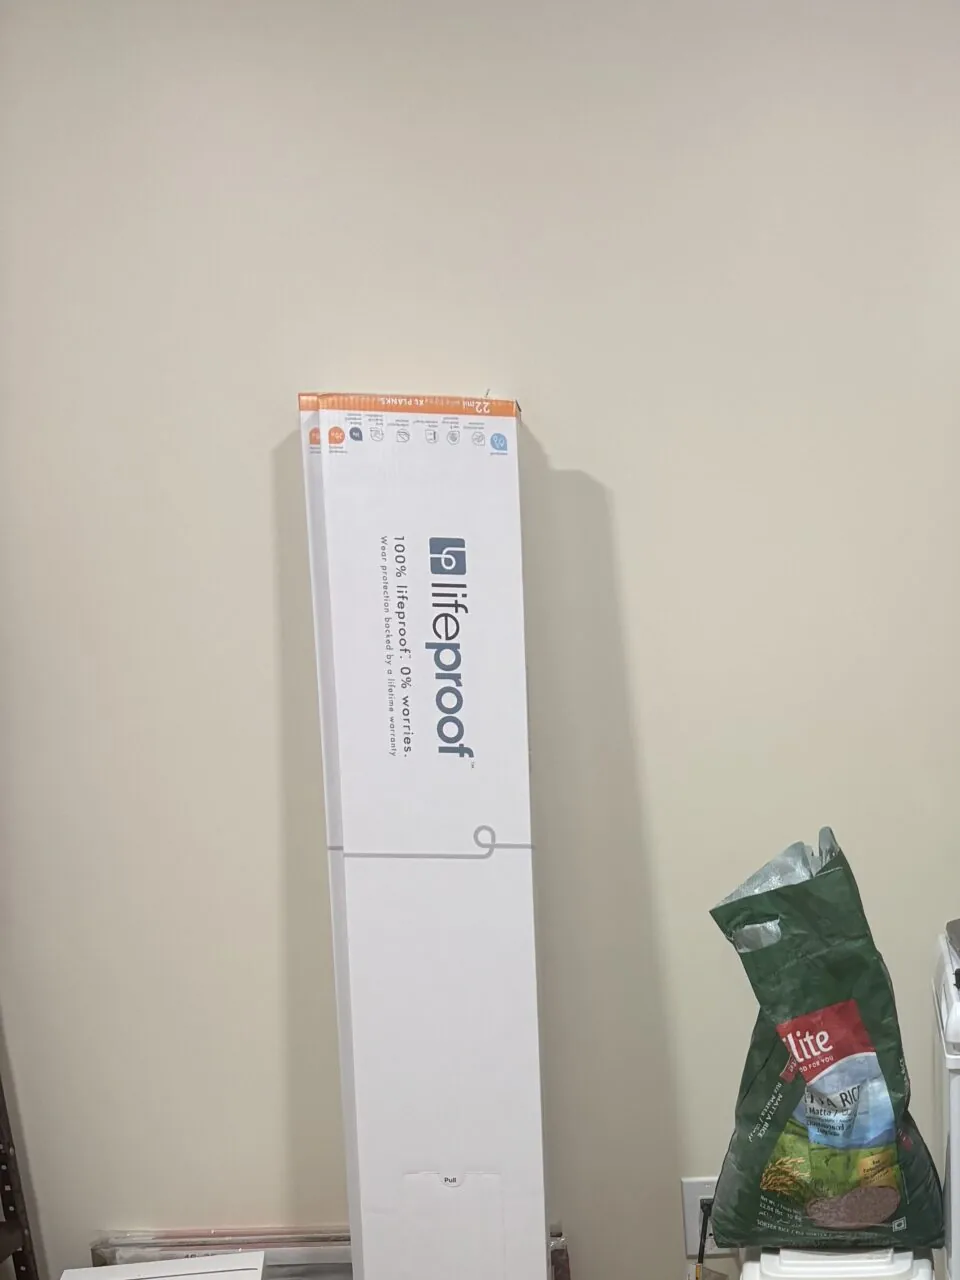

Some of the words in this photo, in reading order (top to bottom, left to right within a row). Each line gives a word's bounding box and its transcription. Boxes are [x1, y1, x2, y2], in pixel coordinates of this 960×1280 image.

[380, 536, 388, 562] Wear
[394, 536, 407, 577] 100%
[380, 566, 391, 613] protection
[384, 617, 394, 651] backed
[385, 654, 394, 665] by
[425, 582, 474, 758] lifeproof
[400, 666, 412, 688] 0%
[388, 678, 396, 712] lifetime
[389, 717, 397, 756] warranty
[402, 696, 414, 757] worries.
[782, 1030, 834, 1063] lite
[808, 1061, 820, 1070] FOR
[821, 1055, 834, 1064] YOU
[765, 1093, 783, 1120] MATTA
[757, 1121, 769, 1139] RICE
